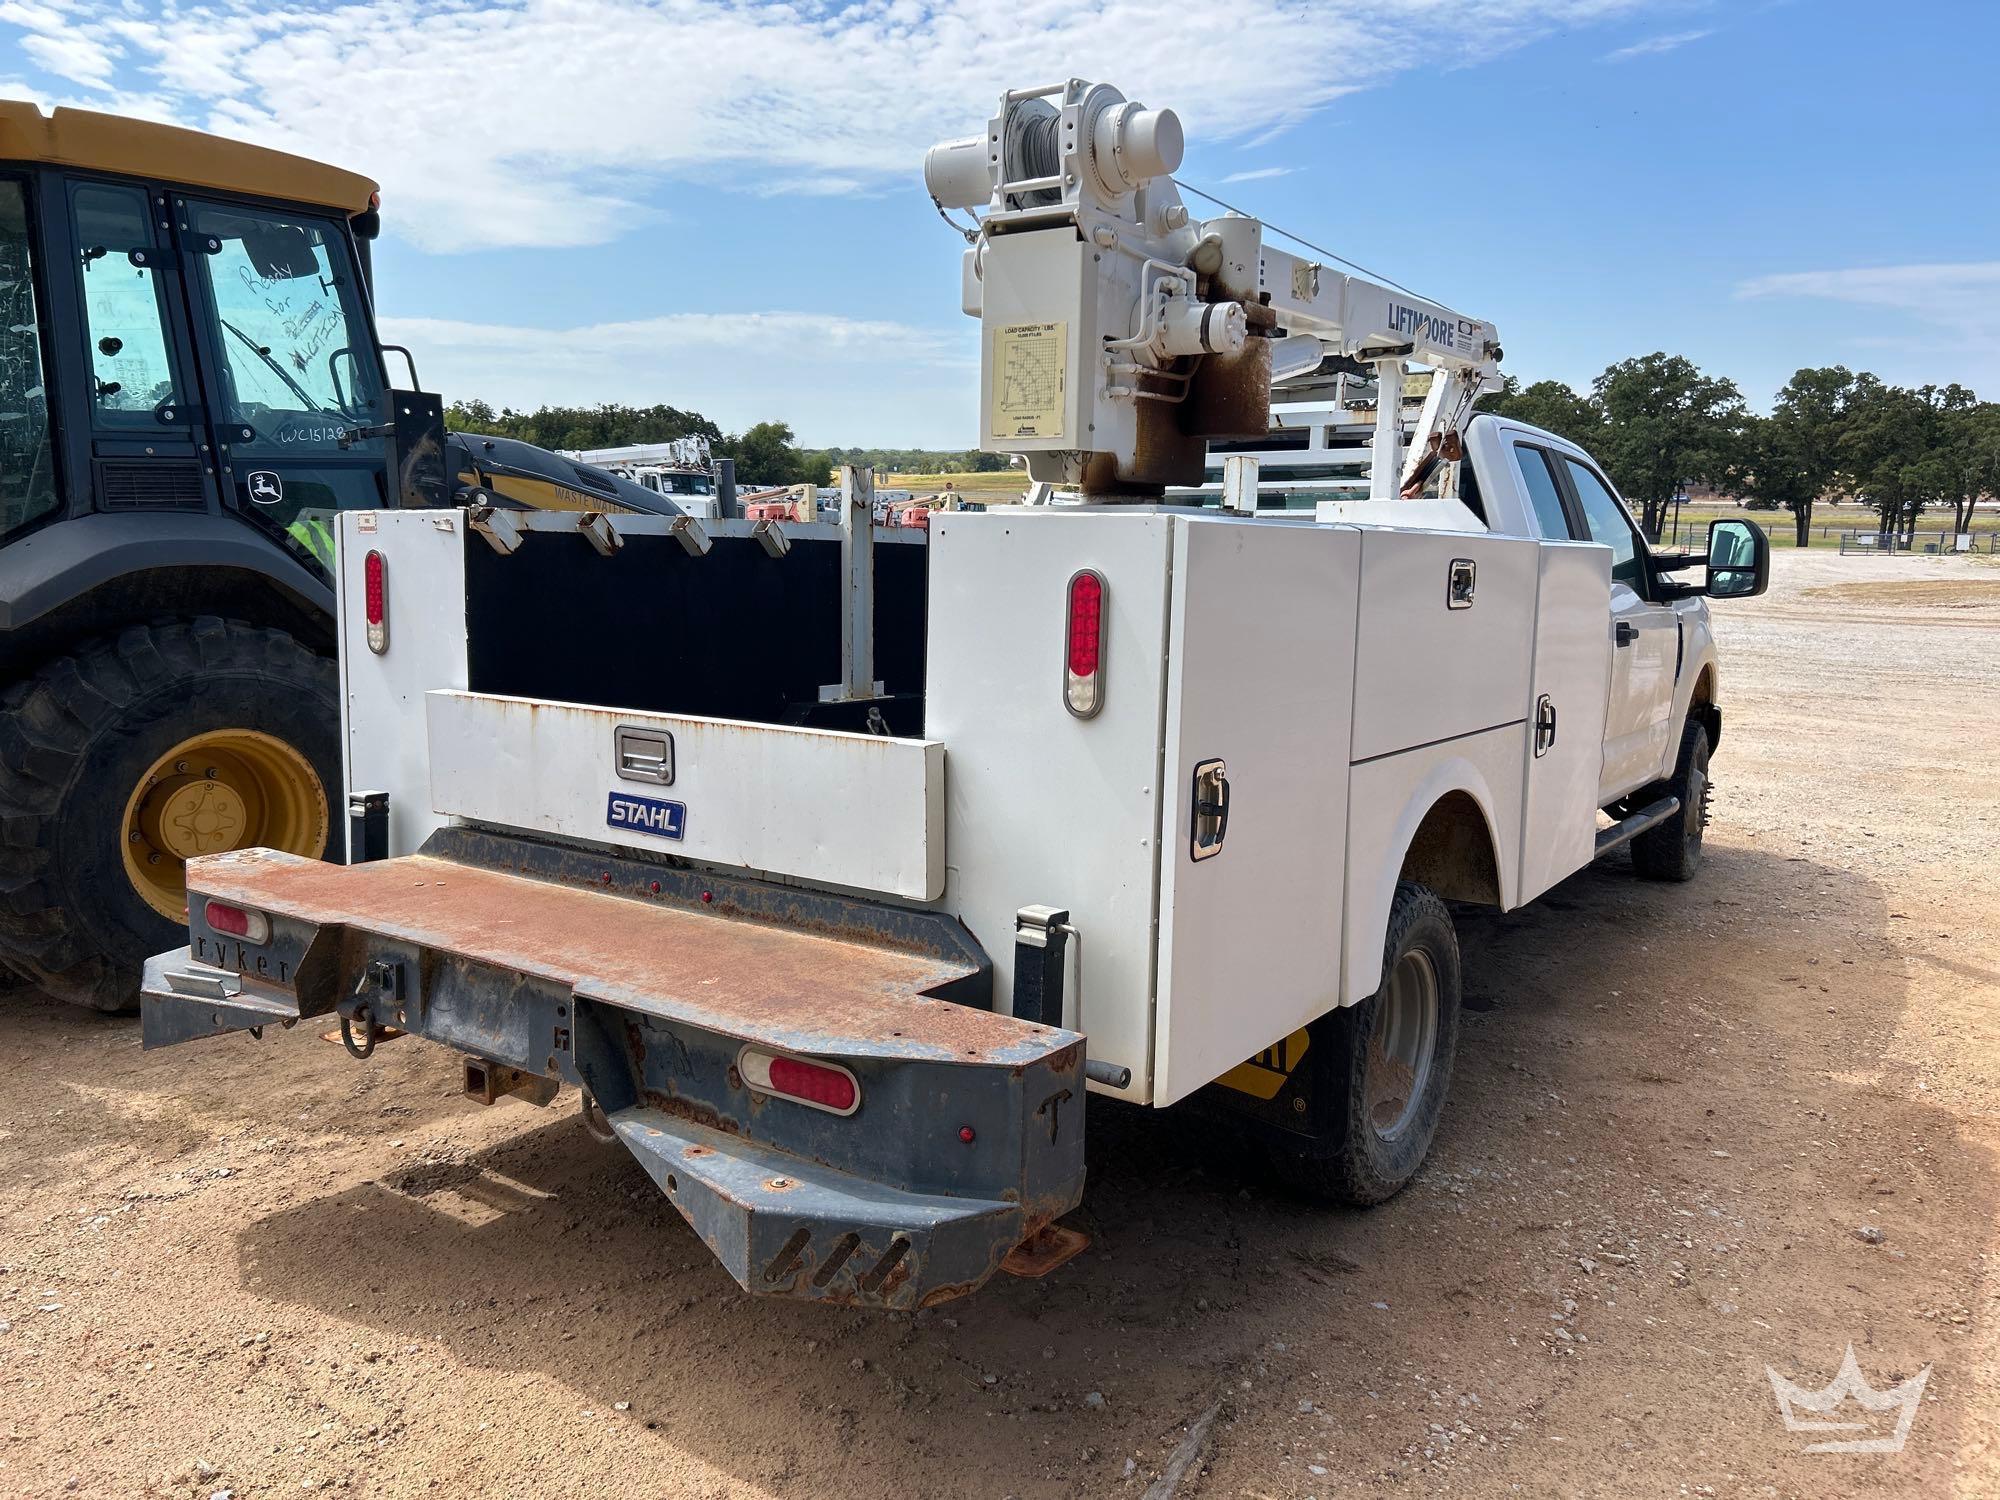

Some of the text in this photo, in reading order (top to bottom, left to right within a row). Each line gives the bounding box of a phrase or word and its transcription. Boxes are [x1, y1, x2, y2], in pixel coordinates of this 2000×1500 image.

[239, 263, 294, 294] Ready
[265, 296, 290, 316] for
[1388, 303, 1454, 347] LIFTMOORE
[554, 486, 590, 507] WASTE
[611, 799, 677, 832] STAHL
[197, 936, 289, 982] ryker
